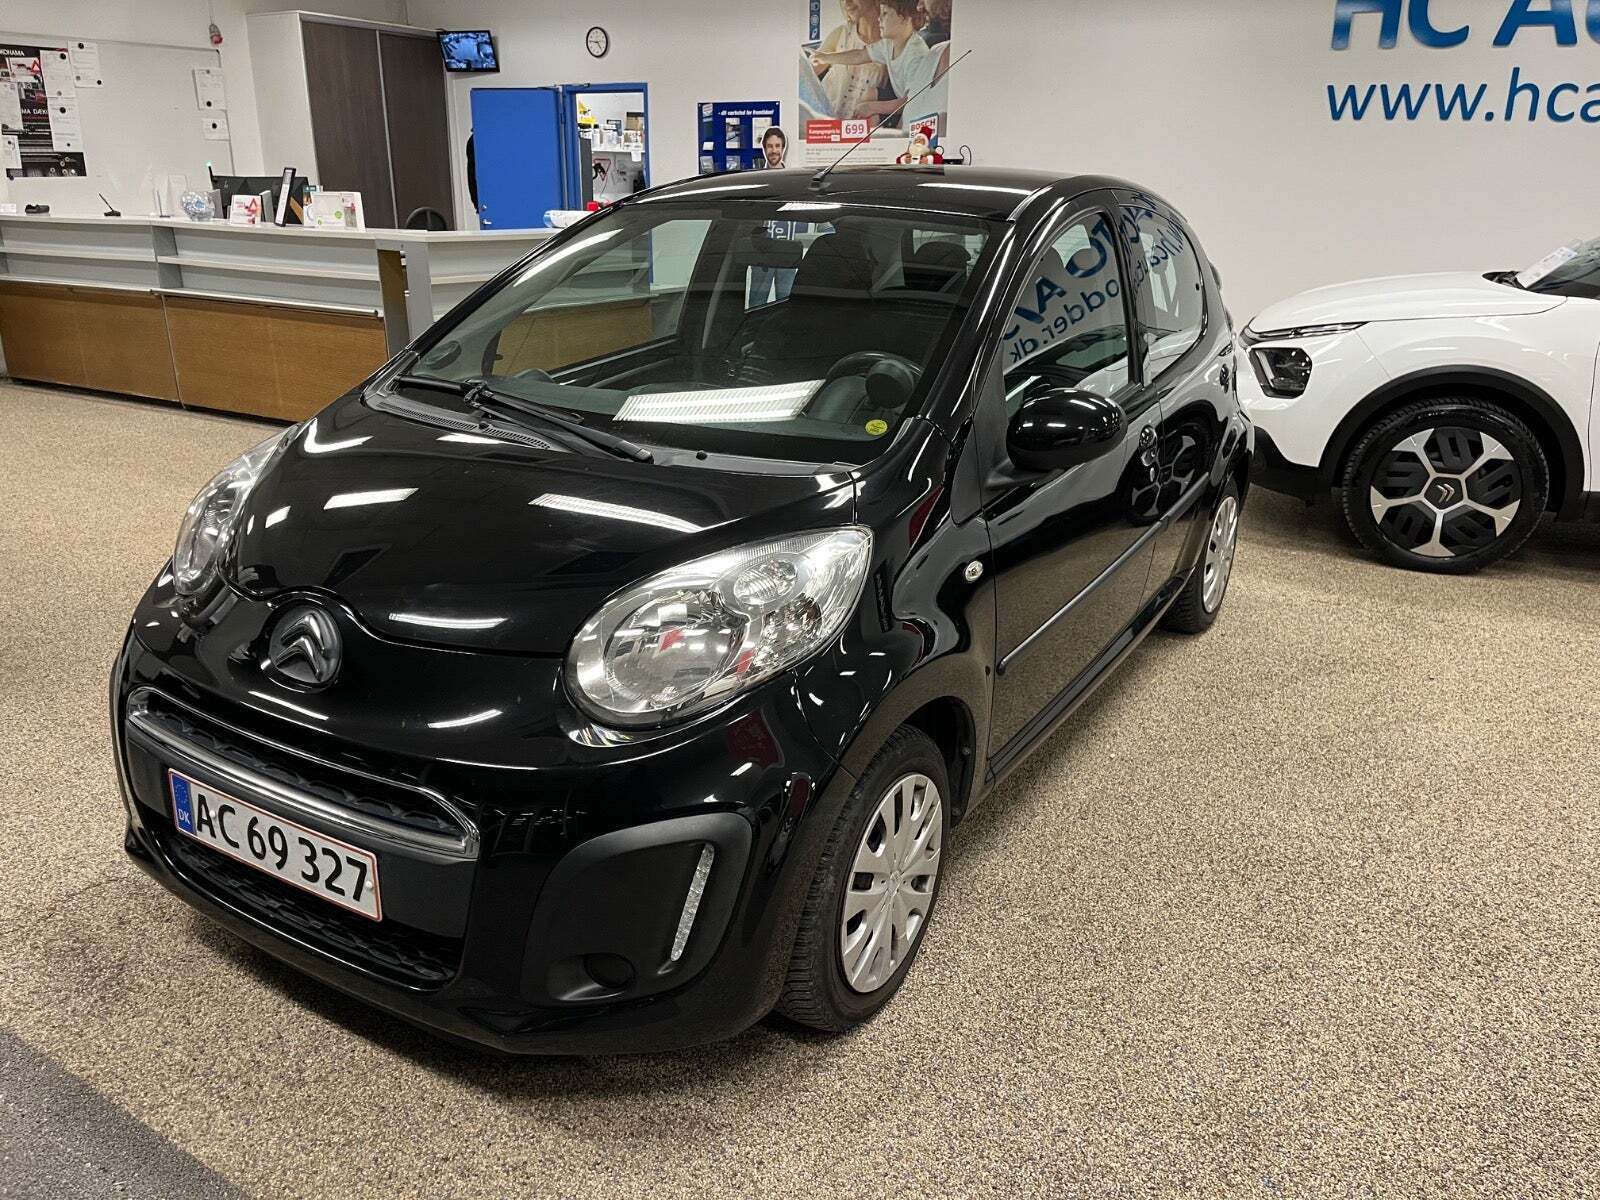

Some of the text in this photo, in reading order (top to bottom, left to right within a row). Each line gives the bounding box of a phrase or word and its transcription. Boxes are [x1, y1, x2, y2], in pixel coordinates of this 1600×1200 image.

[845, 122, 865, 135] 699
[177, 808, 191, 825] DK
[196, 793, 368, 903] AC 69 327
